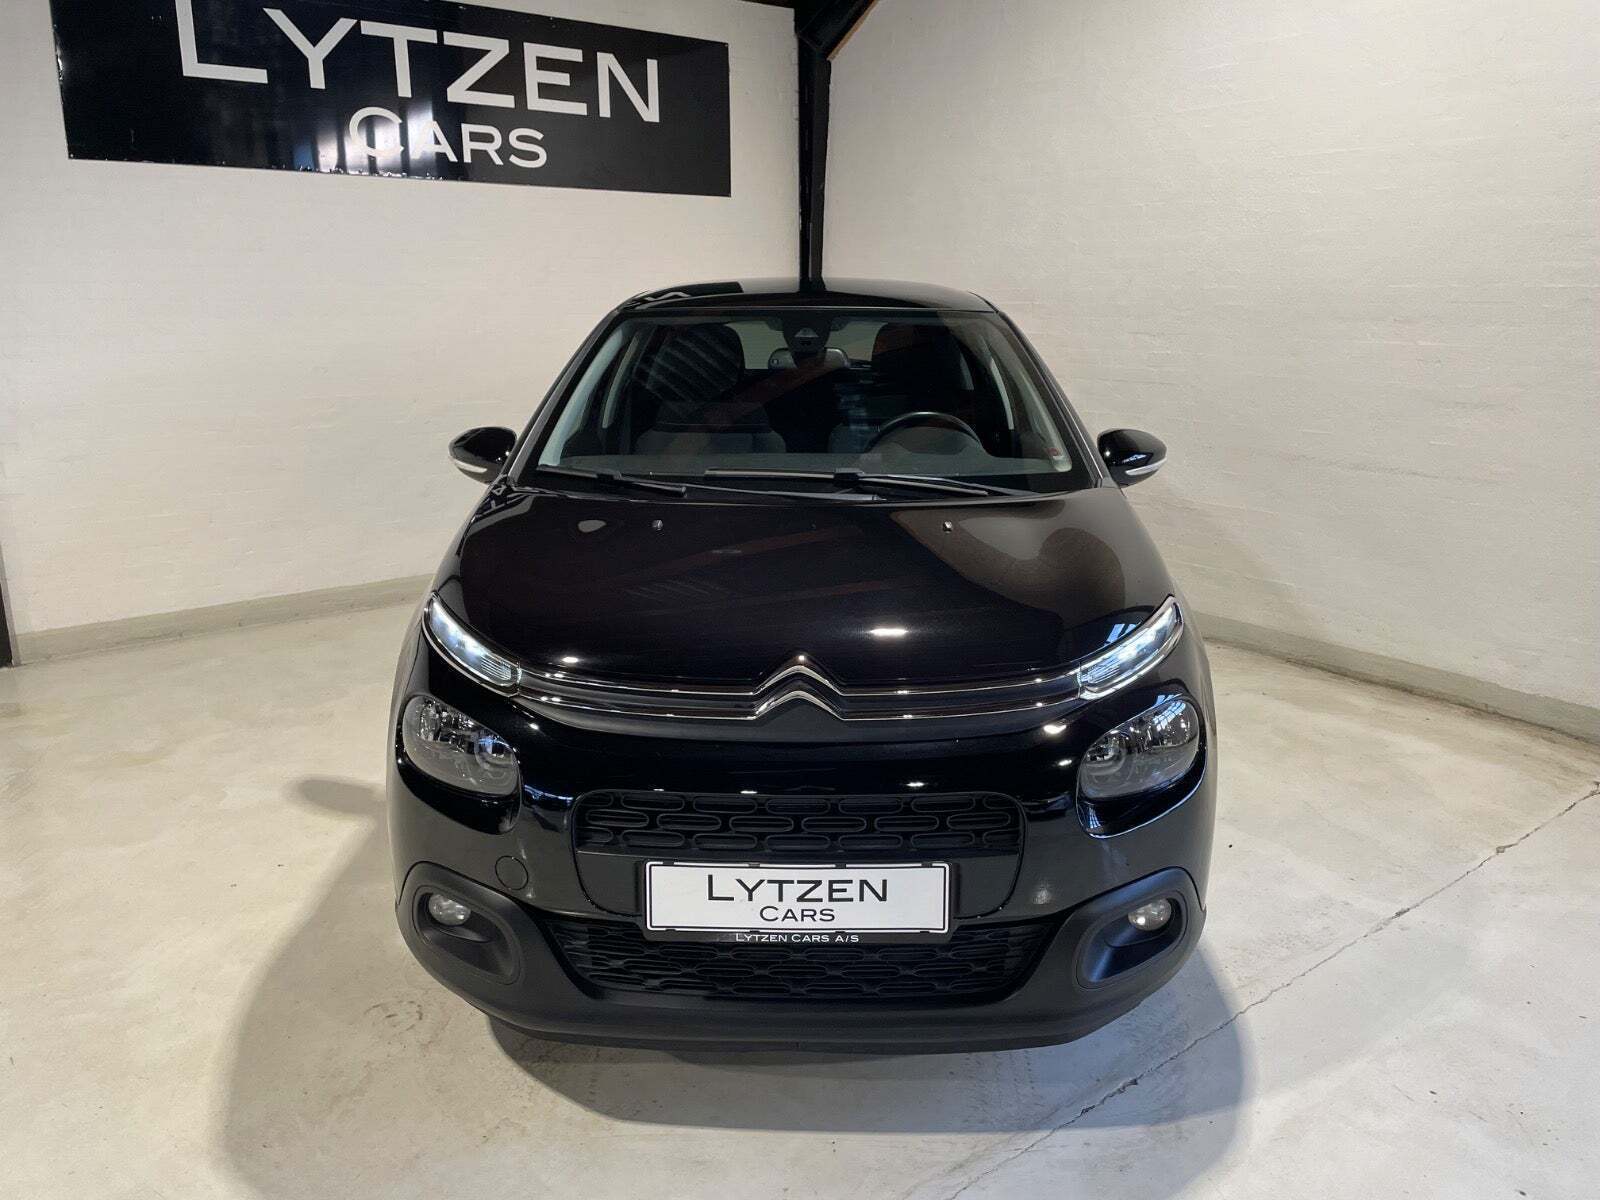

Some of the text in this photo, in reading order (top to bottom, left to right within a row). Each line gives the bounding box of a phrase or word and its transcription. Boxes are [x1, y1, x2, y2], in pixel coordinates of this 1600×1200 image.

[175, 0, 660, 123] LYTZEN
[347, 106, 549, 170] CARS
[707, 874, 888, 903] LYTZEN
[759, 905, 836, 923] CARS
[735, 932, 860, 944] LYTZEN CARS A/S
